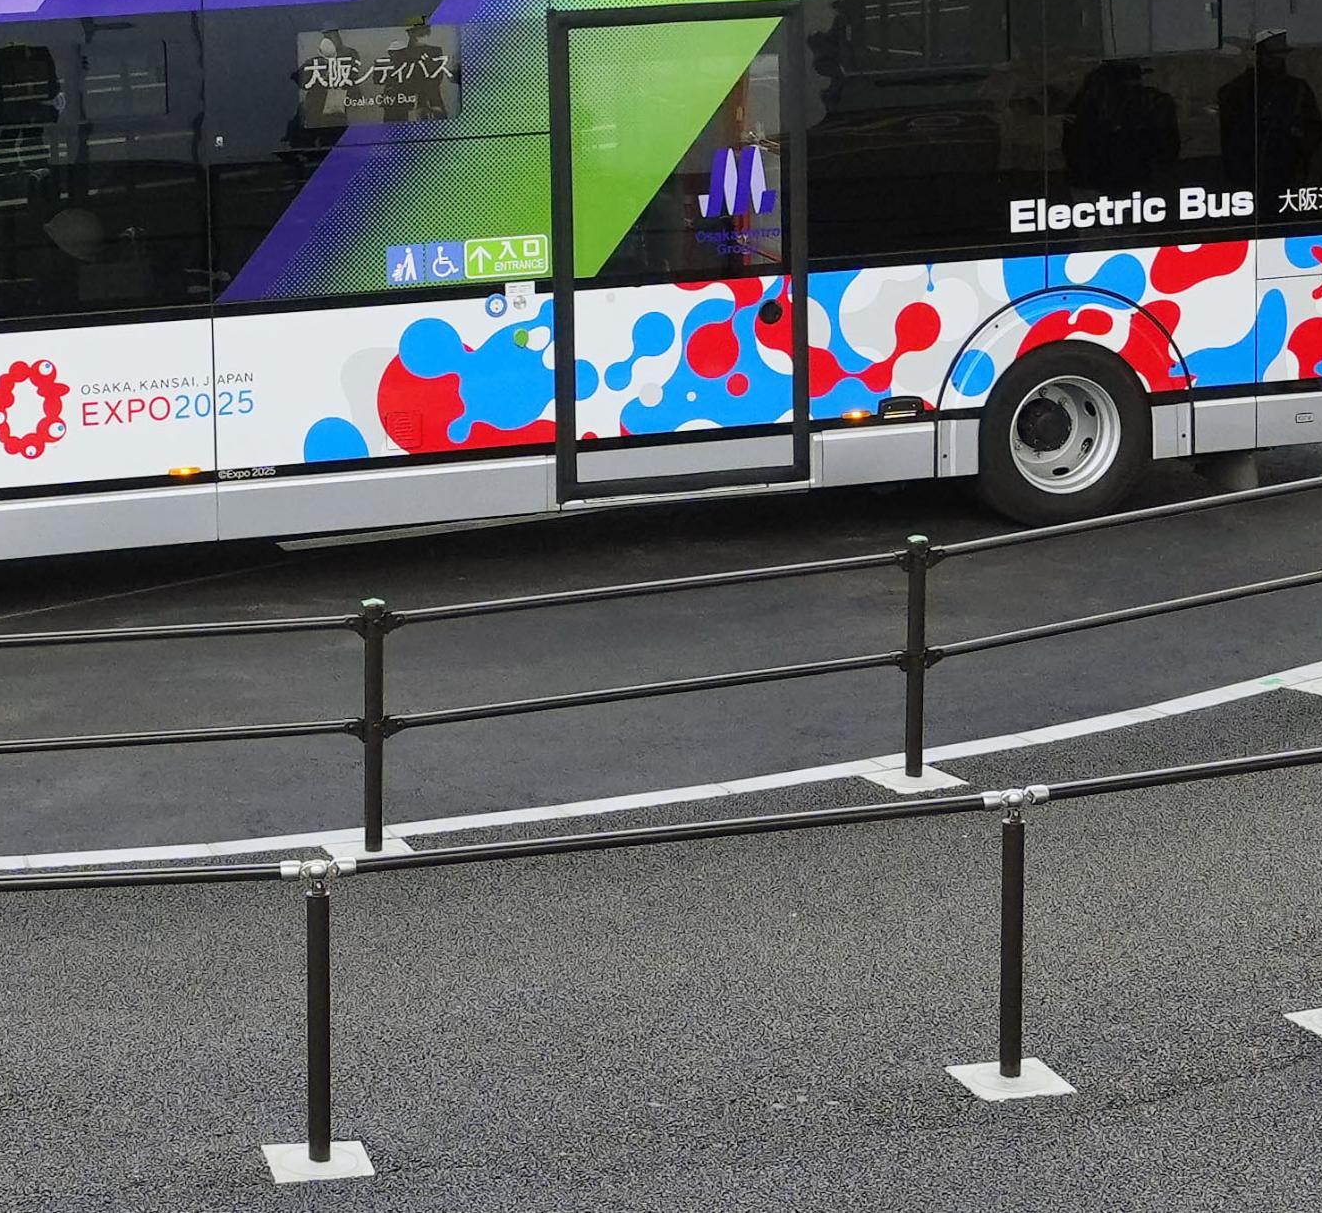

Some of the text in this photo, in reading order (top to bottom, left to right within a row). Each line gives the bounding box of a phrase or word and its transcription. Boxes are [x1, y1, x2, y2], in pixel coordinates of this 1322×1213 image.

[304, 53, 453, 88] 大阪シティバス
[343, 92, 417, 107] Osaka City Bus
[1010, 187, 1255, 233] Electric Bus
[498, 240, 540, 260] 入口
[494, 259, 544, 272] ENTRANCE
[80, 381, 136, 396] OSAKA,
[203, 372, 254, 387] JAPAN
[81, 389, 255, 427] EXPO2025
[252, 466, 276, 477] 2025
